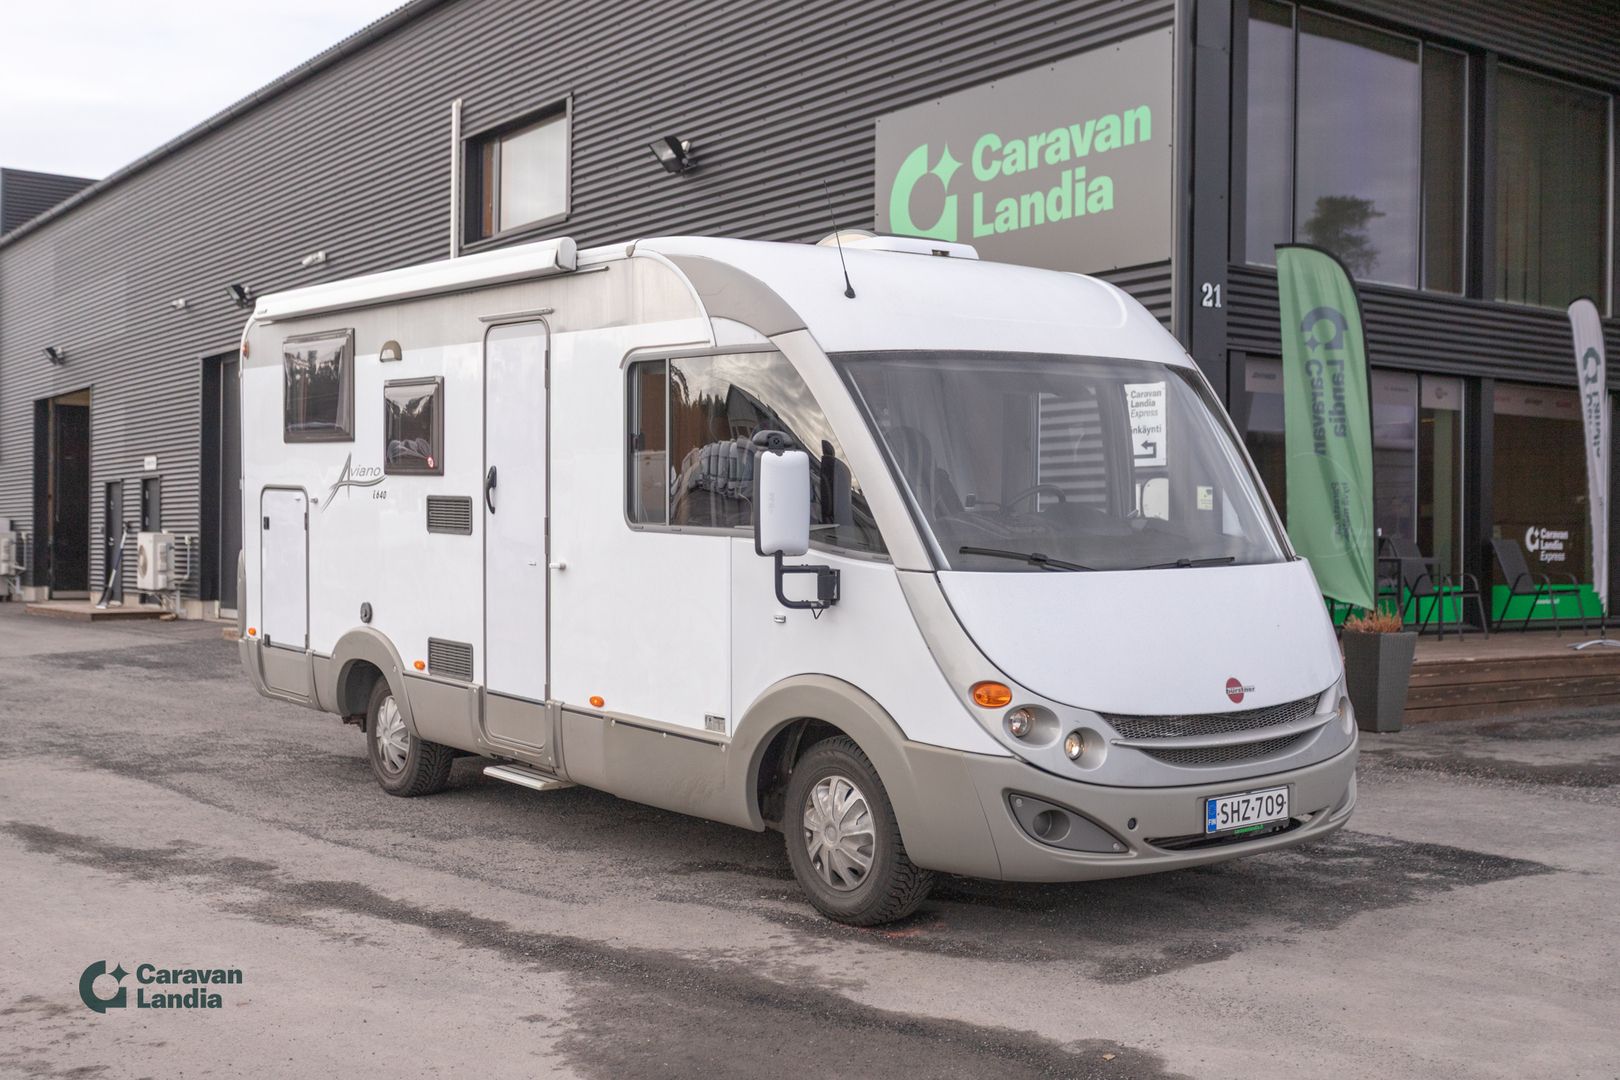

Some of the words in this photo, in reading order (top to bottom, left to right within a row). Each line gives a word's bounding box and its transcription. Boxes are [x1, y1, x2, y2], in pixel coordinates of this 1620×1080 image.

[972, 104, 1152, 182] Caravan
[973, 166, 1114, 238] Landia
[1202, 282, 1222, 308] 21
[1130, 390, 1162, 399] Caravan
[1130, 399, 1156, 408] Landia
[1130, 409, 1159, 418] Express
[1131, 424, 1162, 436] nkäynti
[322, 452, 382, 511] Aviano
[1221, 793, 1285, 825] SHZ-709
